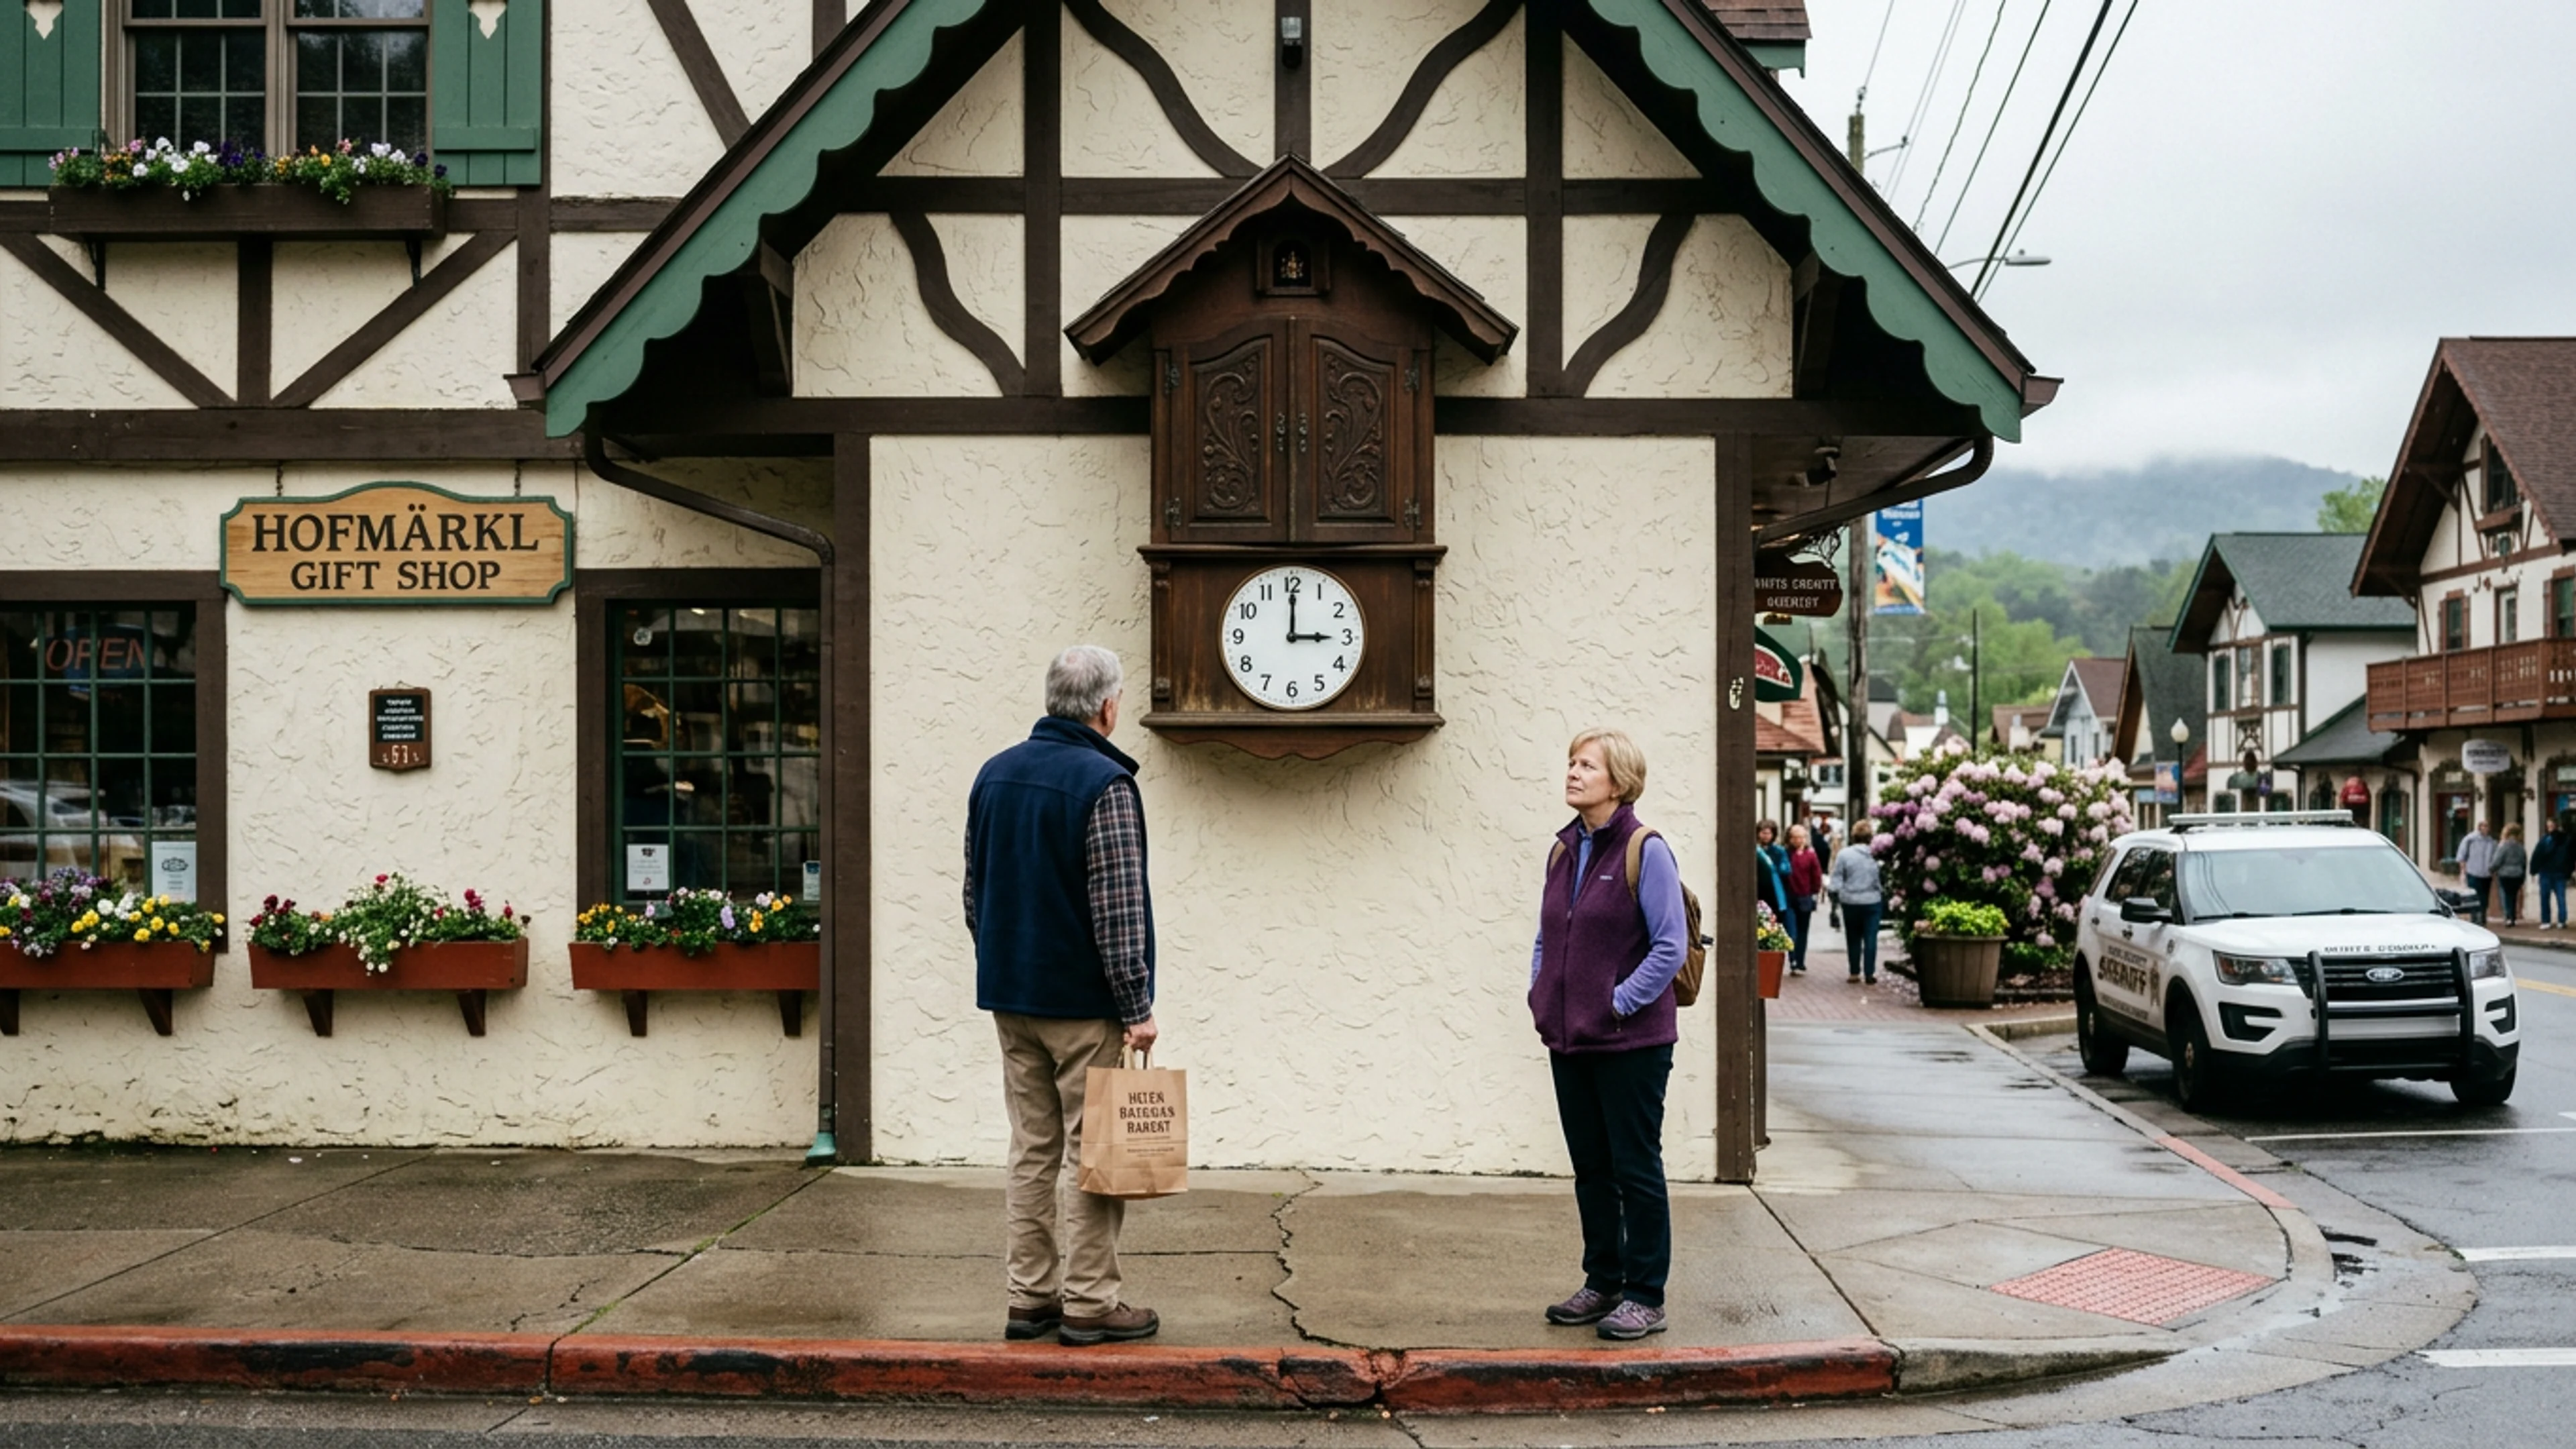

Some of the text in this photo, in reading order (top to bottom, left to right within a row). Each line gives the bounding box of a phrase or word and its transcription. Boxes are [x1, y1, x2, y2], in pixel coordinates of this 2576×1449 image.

[252, 504, 539, 552] HOFMÄRKL
[290, 560, 501, 590] GIFT SHOP
[1259, 584, 1273, 601] 11
[1284, 576, 1301, 594] 12
[1317, 583, 1322, 600] 1
[1240, 602, 1257, 620] 10
[1332, 602, 1344, 618] 2
[1232, 628, 1244, 645] 9
[1342, 628, 1353, 646] 3
[1240, 655, 1252, 672] 8
[1332, 655, 1346, 672] 4
[1260, 674, 1272, 691] 7
[1286, 681, 1298, 698] 6
[1313, 674, 1325, 692] 5
